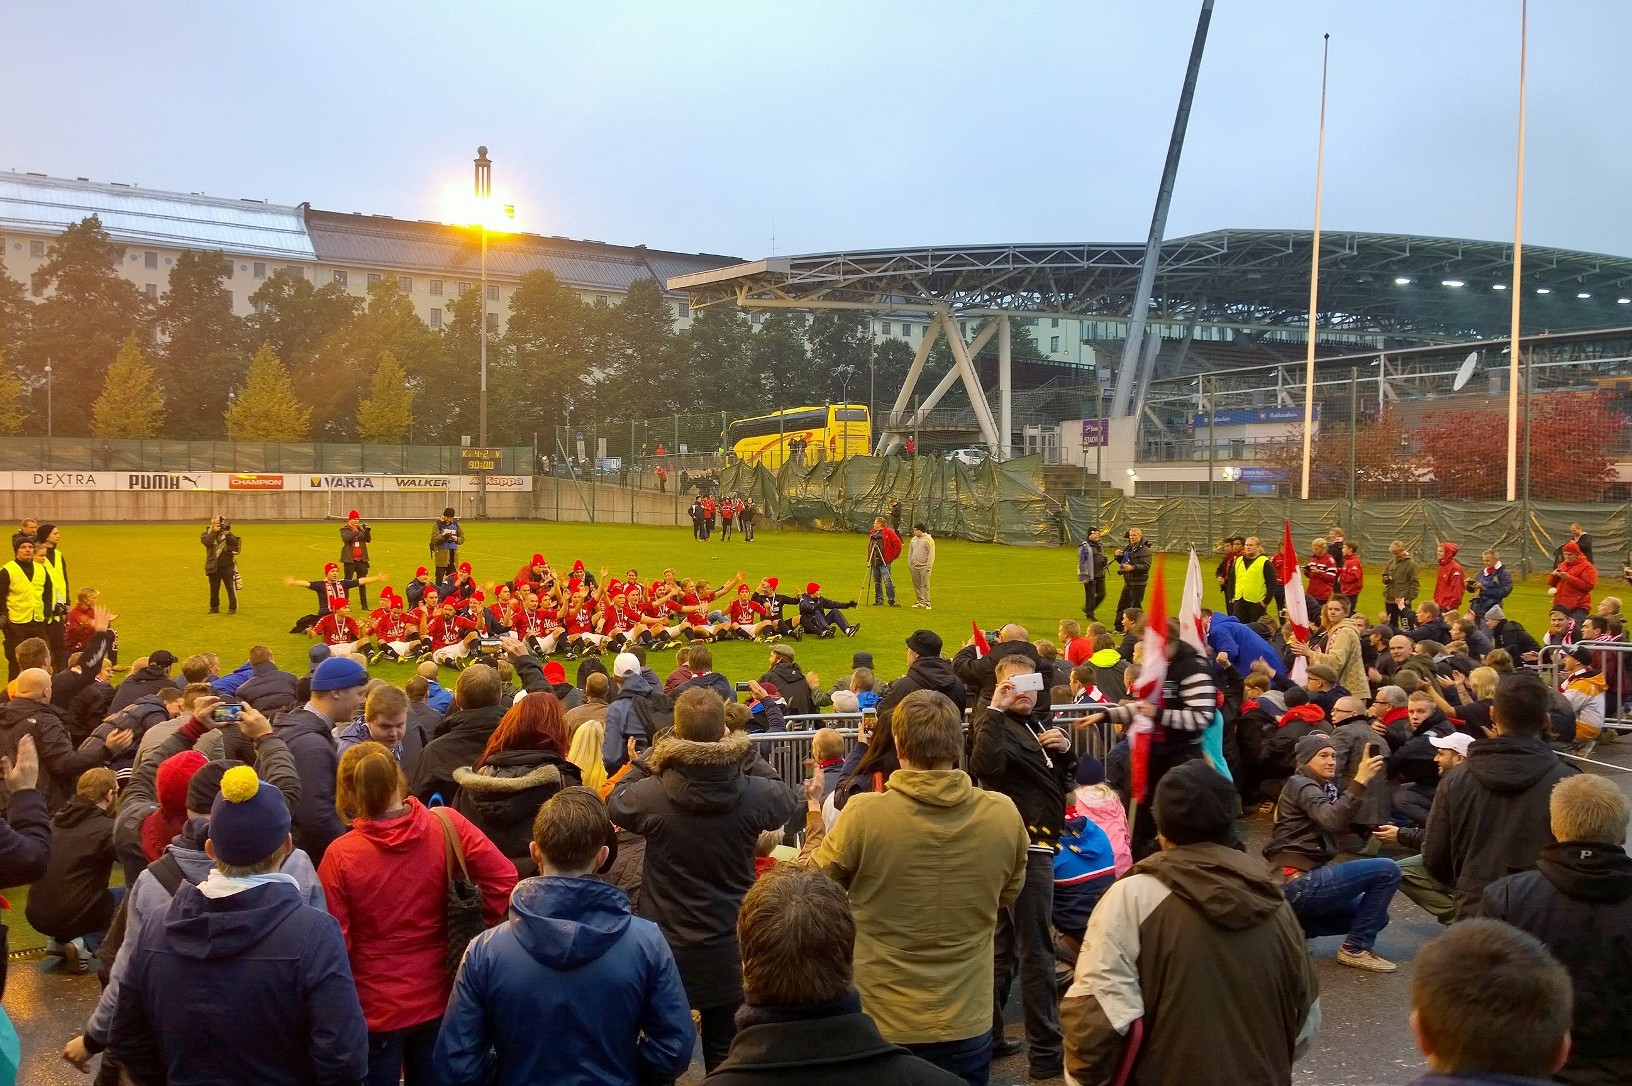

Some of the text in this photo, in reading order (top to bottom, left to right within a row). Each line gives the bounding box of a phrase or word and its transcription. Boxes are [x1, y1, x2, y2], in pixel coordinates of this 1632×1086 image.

[474, 449, 489, 457] 4-2
[468, 460, 494, 470] 90:00
[33, 473, 96, 488] DEXTRA
[128, 474, 181, 490] PUMA
[231, 478, 283, 486] CHAMPION
[323, 476, 375, 488] VARTA
[395, 477, 451, 487] WALKER
[485, 476, 524, 487] Kappa
[1580, 850, 1593, 860] P
